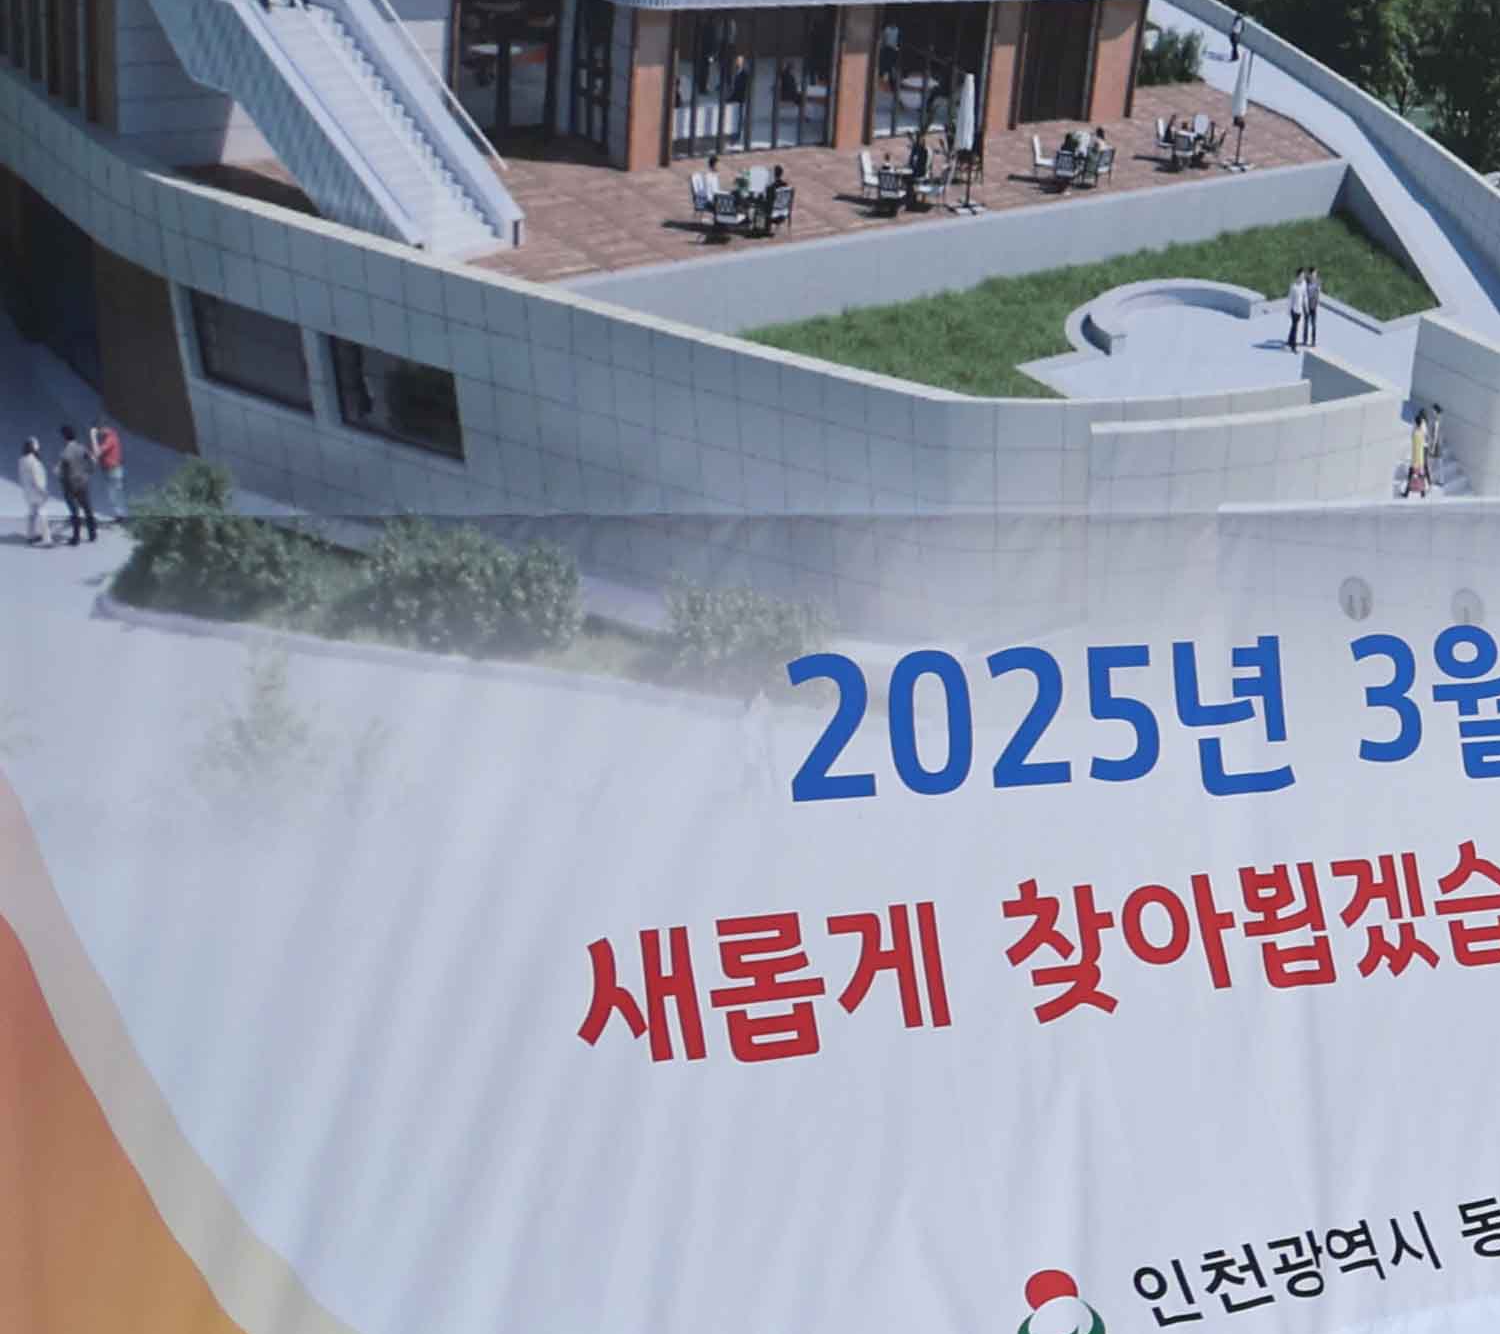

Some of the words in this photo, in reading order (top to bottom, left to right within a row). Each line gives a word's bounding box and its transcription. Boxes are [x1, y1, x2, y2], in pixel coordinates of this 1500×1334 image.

[787, 633, 1295, 802] 2025년
[577, 902, 952, 1063] 새롭게
[1132, 1210, 1442, 1328] 인천광역시
